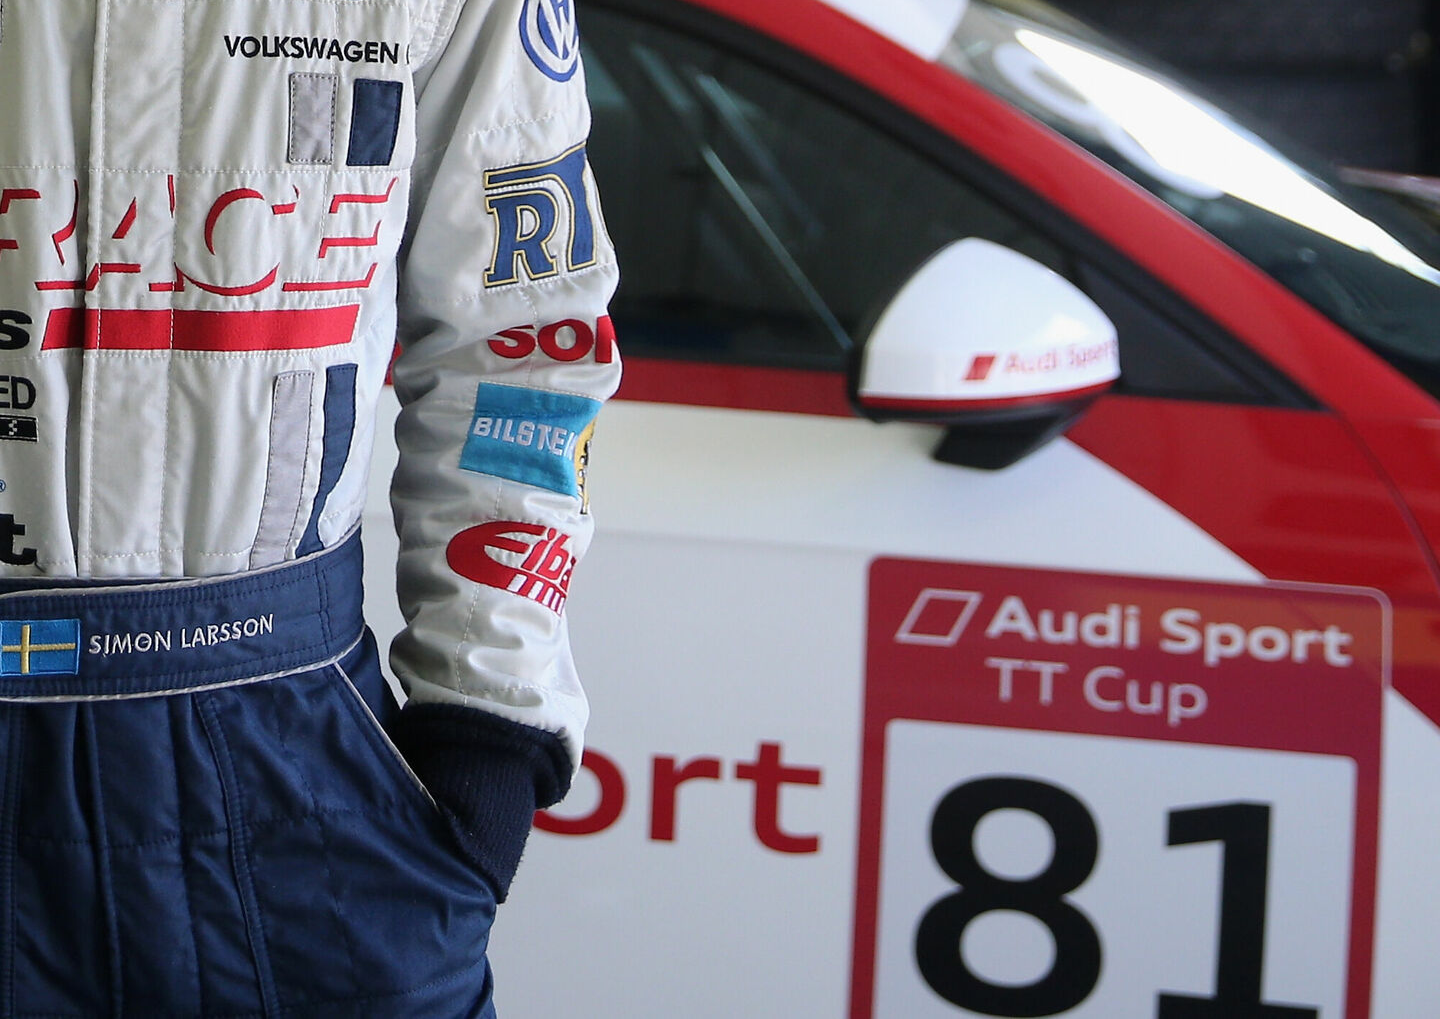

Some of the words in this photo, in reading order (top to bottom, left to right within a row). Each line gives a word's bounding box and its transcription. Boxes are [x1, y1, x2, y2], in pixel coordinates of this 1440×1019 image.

[224, 35, 399, 64] VOLKSWAGEN
[1005, 350, 1058, 374] Audi
[89, 630, 171, 656] SIMON
[181, 613, 274, 649] LARSSON
[985, 596, 1142, 650] Audi
[1157, 607, 1354, 667] Sport
[984, 657, 1069, 706] TT
[1082, 666, 1209, 727] Cup
[912, 772, 1321, 1019] 81
